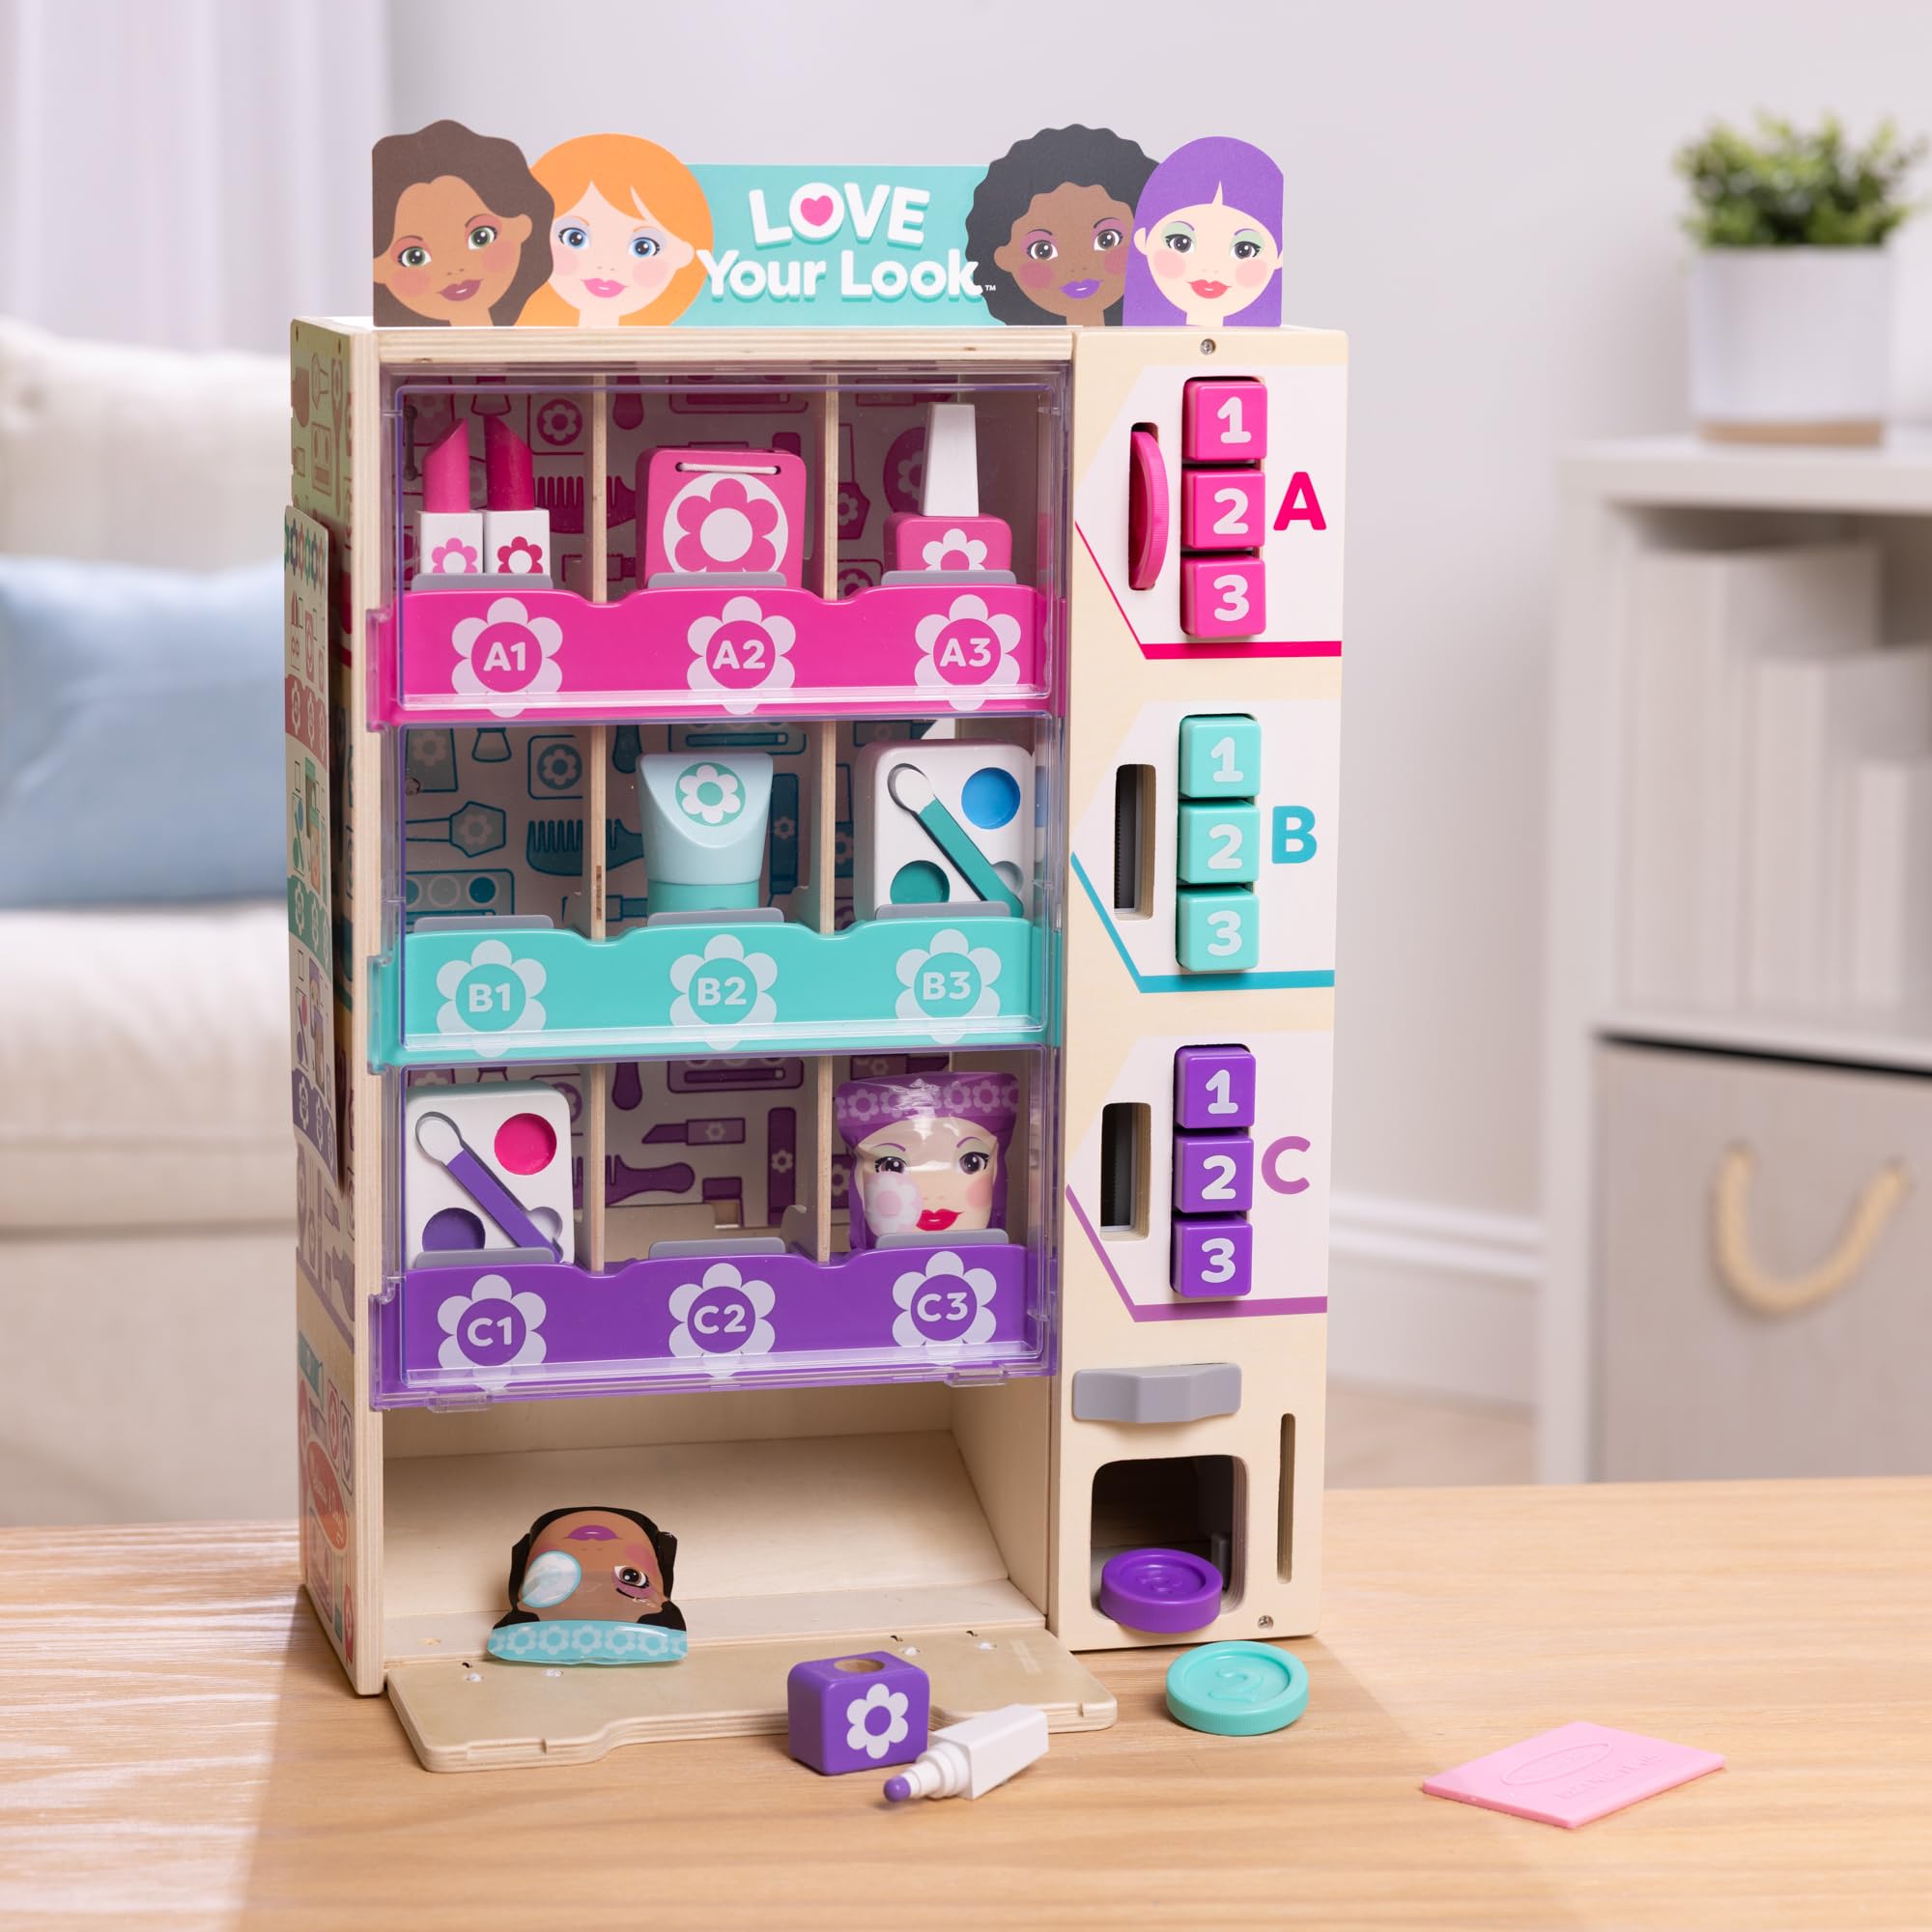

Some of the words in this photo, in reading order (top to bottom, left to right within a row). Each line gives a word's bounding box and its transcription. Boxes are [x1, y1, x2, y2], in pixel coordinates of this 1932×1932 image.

[749, 182, 930, 245] LOVE
[696, 249, 827, 297] Your
[840, 248, 983, 297] Look
[1217, 396, 1252, 444] 1
[1212, 487, 1249, 534] 2
[1273, 471, 1327, 531] A
[1212, 574, 1249, 622] 3
[483, 641, 526, 671] A1
[712, 639, 766, 670] A2
[939, 638, 991, 668] A3
[1210, 736, 1244, 782] 1
[1208, 824, 1243, 869] 2
[1271, 806, 1318, 864] B
[1208, 910, 1242, 956] 3
[469, 982, 511, 1012] B1
[697, 977, 747, 1006] B2
[923, 971, 972, 1000] B3
[1206, 1069, 1238, 1114] 1
[1201, 1154, 1236, 1200] 2
[1261, 1136, 1311, 1195] C
[1201, 1237, 1236, 1283] 3
[467, 1316, 512, 1347] C1
[694, 1304, 747, 1334] C2
[917, 1292, 968, 1322] C3
